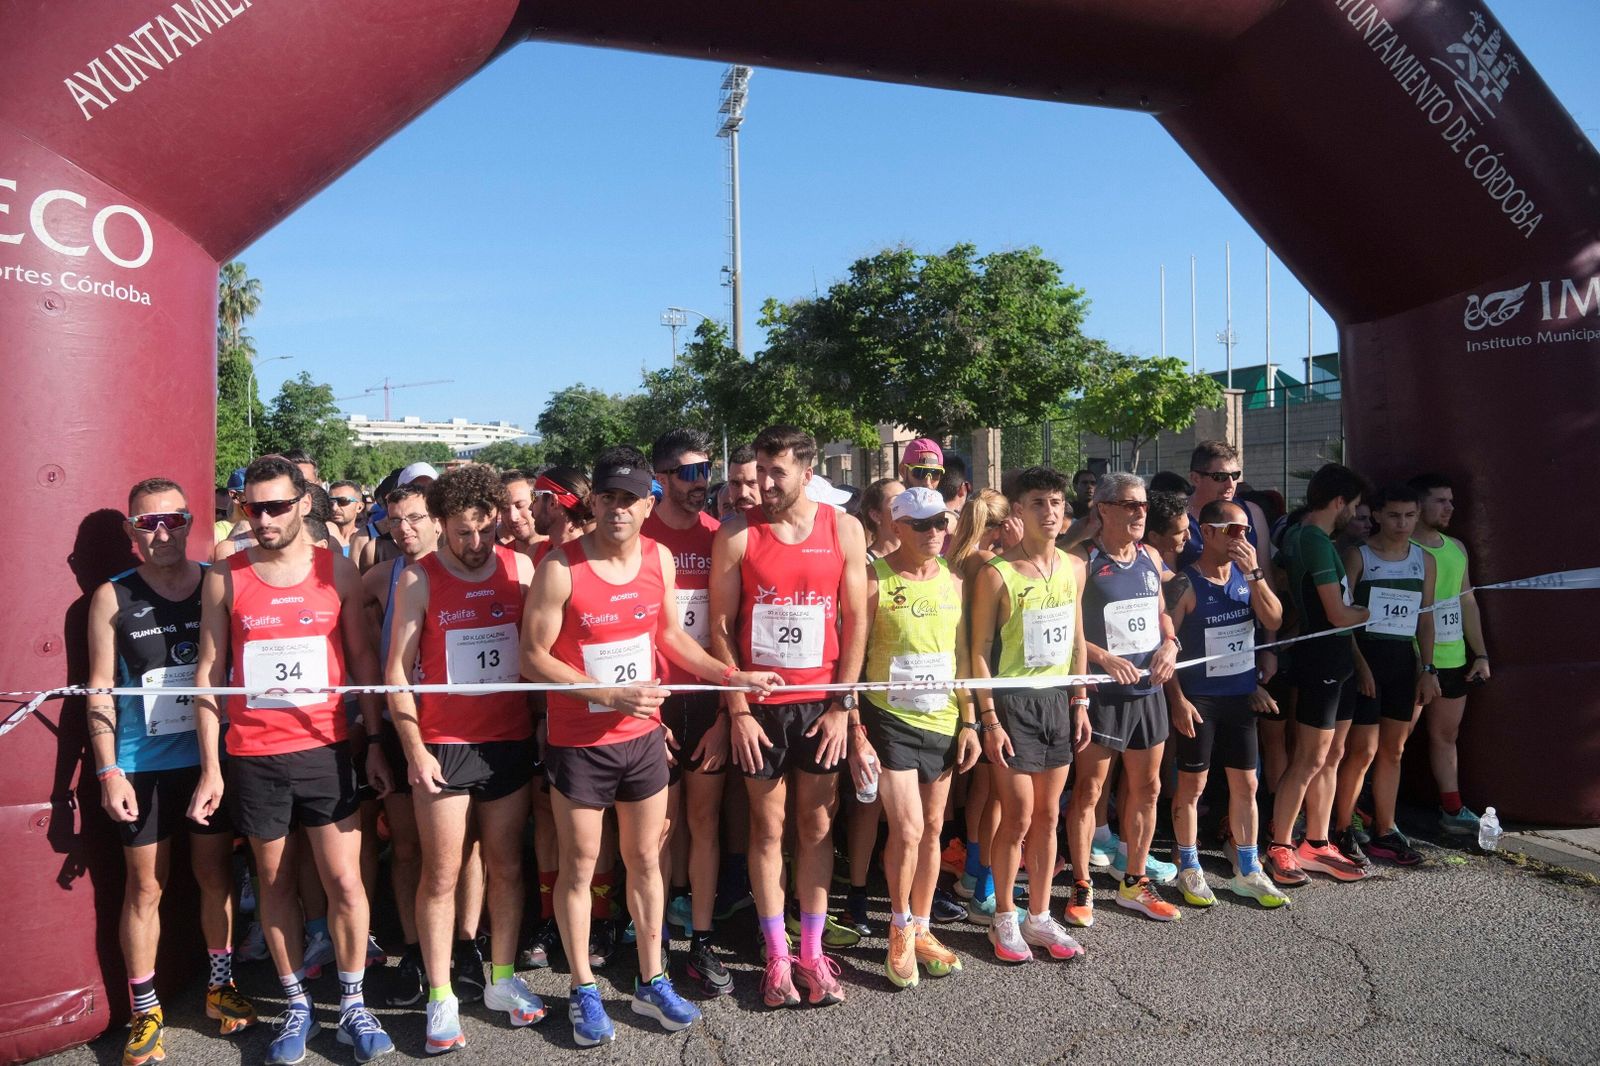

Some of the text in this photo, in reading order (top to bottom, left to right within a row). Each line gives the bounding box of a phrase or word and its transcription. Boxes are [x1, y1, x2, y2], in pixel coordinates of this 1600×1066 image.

[1441, 115, 1476, 153] DE
[1465, 144, 1543, 239] CÓRDOBA
[0, 264, 152, 306] rtes Córdoba
[1466, 335, 1532, 352] Instituto
[446, 609, 476, 622] califas
[590, 613, 619, 624] califas
[1383, 603, 1408, 618] 140
[1441, 612, 1459, 625] 139
[249, 616, 281, 627] califas
[685, 611, 696, 627] 3
[1128, 617, 1146, 632] 69
[130, 624, 177, 639] RUNNING
[778, 627, 802, 644] 29
[1043, 624, 1067, 644] 137
[1228, 641, 1243, 652] 37
[477, 650, 500, 669] 13
[275, 662, 303, 681] 34
[614, 662, 637, 683] 26
